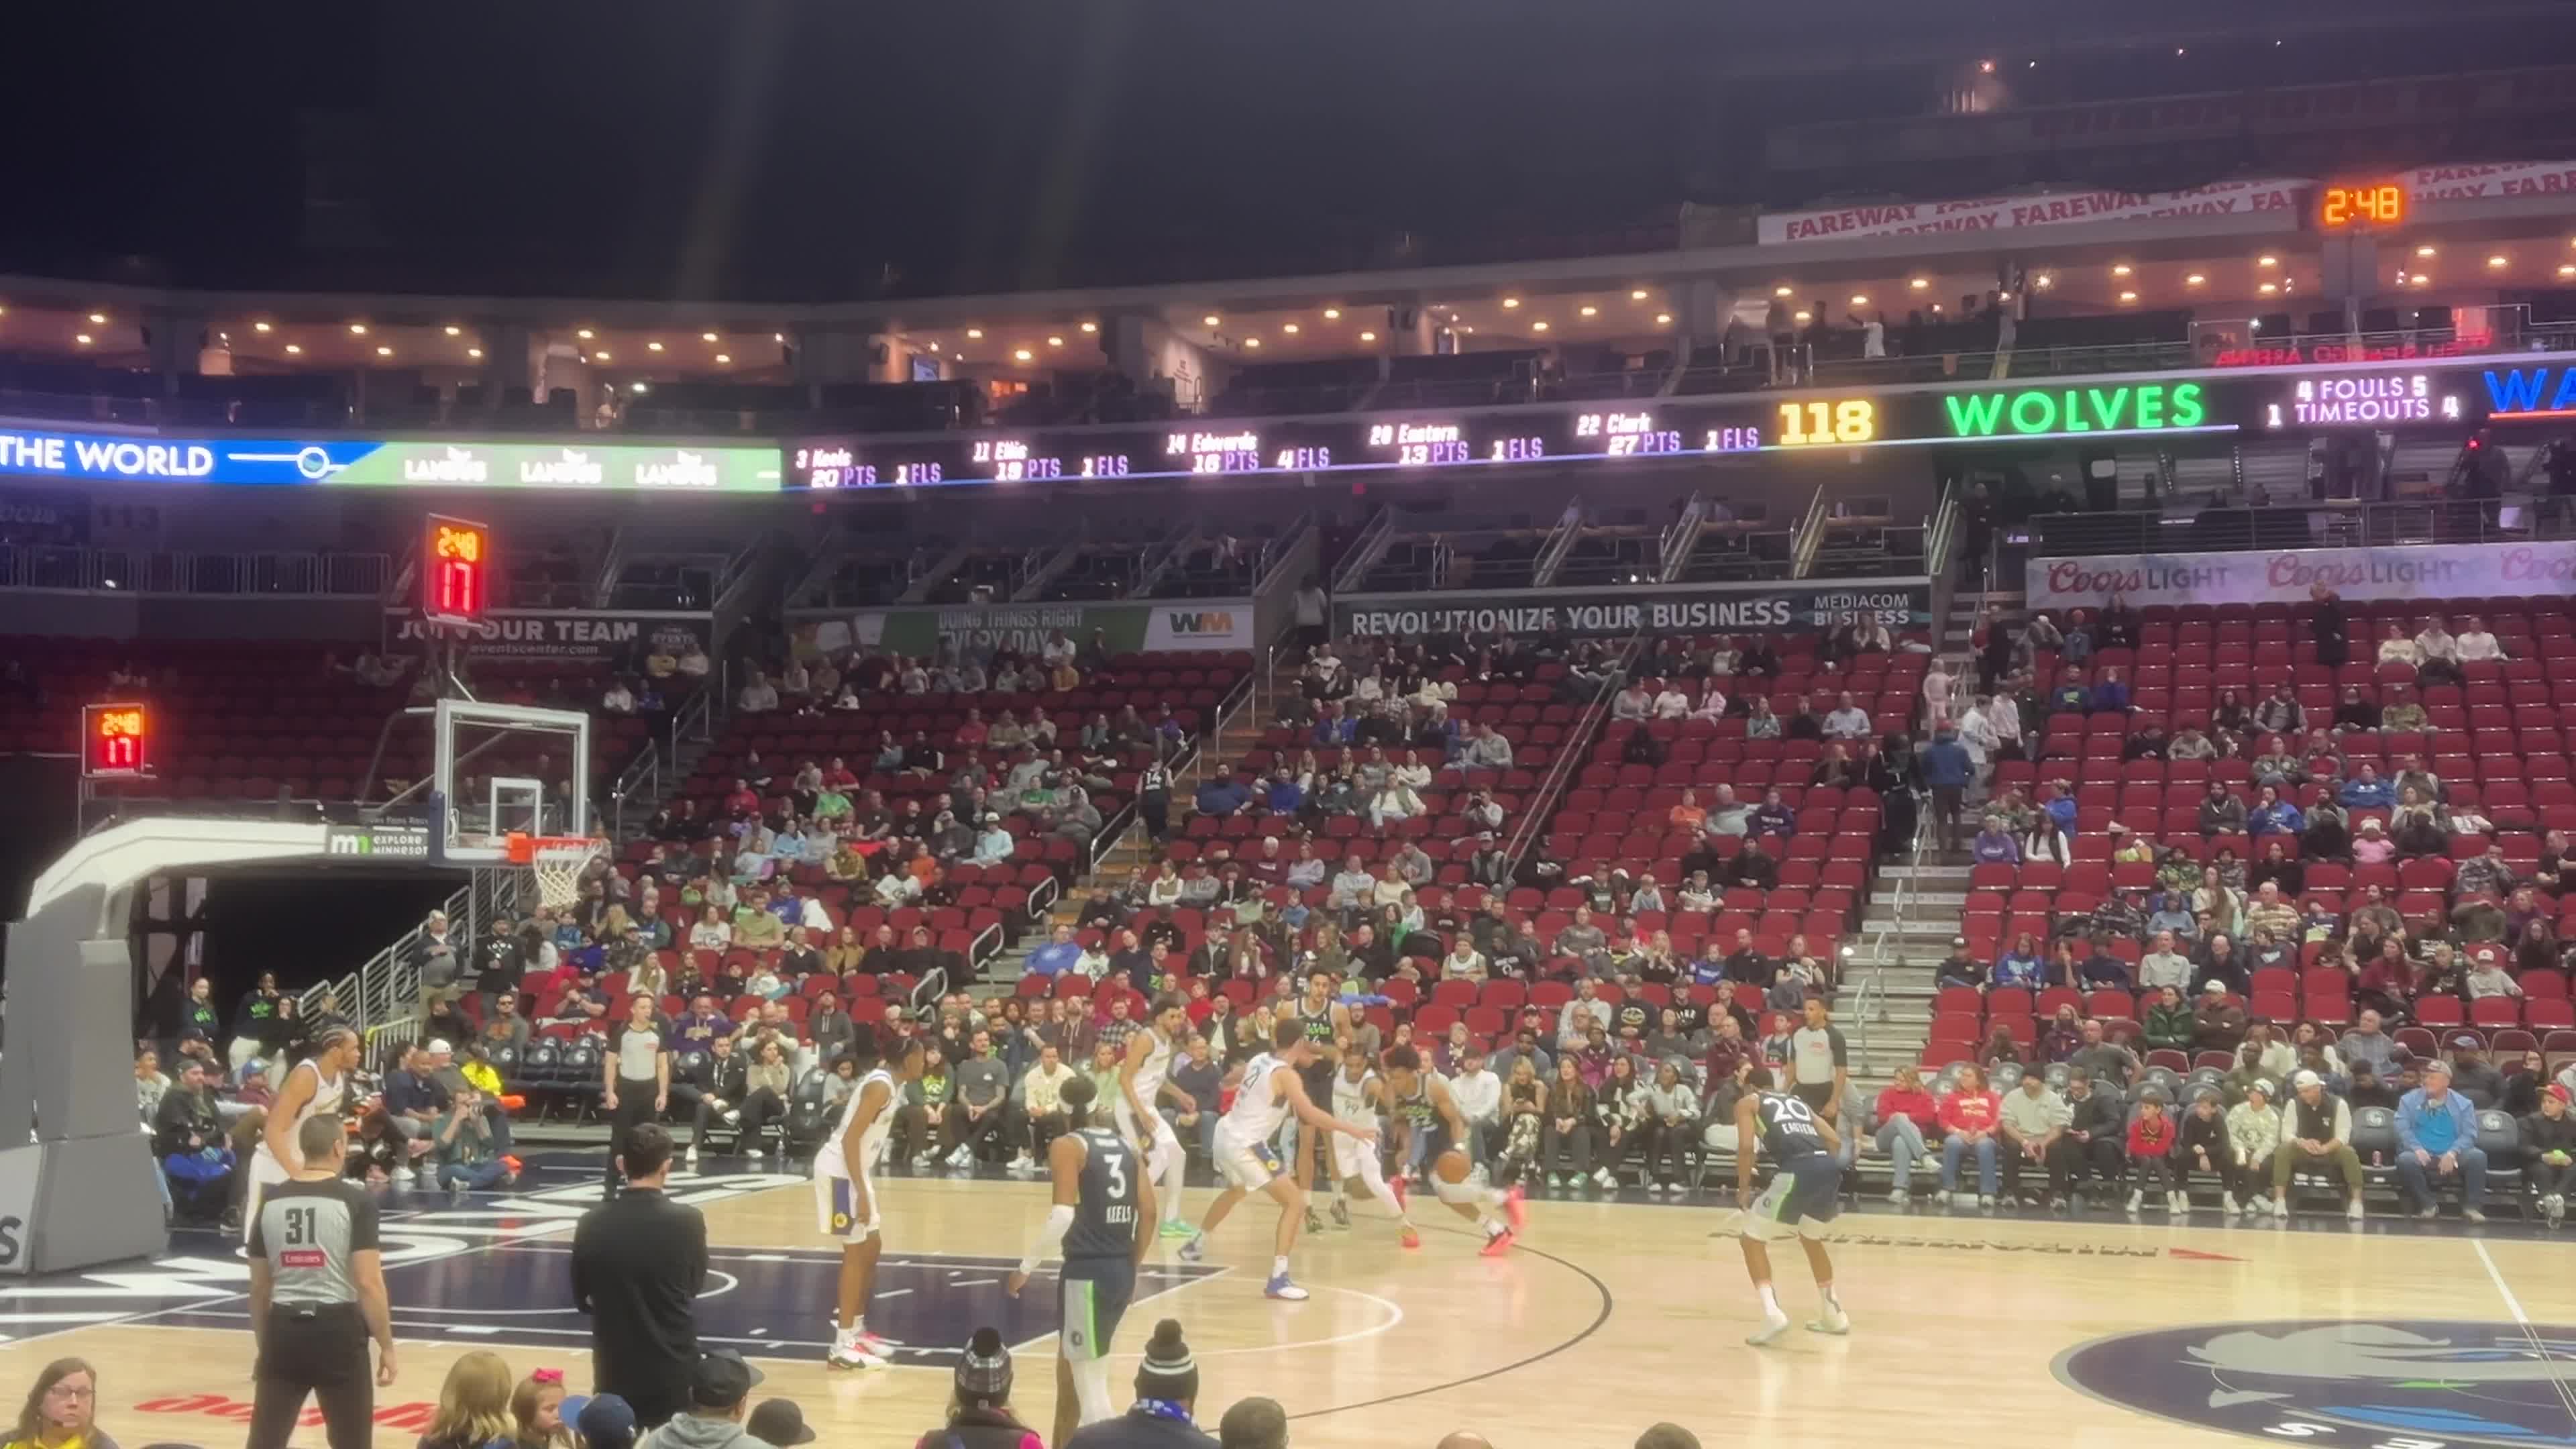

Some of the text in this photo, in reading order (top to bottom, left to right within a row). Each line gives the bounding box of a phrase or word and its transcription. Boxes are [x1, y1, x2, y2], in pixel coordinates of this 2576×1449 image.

[2324, 186, 2399, 224] 2:48
[1786, 203, 1917, 239] FAREWAY
[2297, 375, 2427, 402] 4 FOULS 5
[1779, 400, 1873, 444] 118
[1946, 382, 2203, 436] WOLVES
[2267, 396, 2459, 427] 1 TIMEOUTS 4
[1577, 415, 1601, 436] 22
[1399, 437, 1543, 464] 13 PTS 1 FLS
[1608, 427, 1758, 455] 27 PTS 1 FLS
[0, 436, 213, 476] THE WORLD
[796, 449, 808, 469] 3
[1028, 458, 1061, 478] PTS
[1081, 458, 1093, 477] 1
[1097, 455, 1128, 476] FLS
[1225, 451, 1259, 472] PTS
[1298, 446, 1330, 469] FLS
[844, 465, 876, 486] PTS
[896, 465, 908, 485] 1
[912, 462, 942, 484] FLS
[2047, 560, 2229, 594] Coors LIGHT
[2267, 553, 2458, 588] Coors LIGHT
[443, 561, 472, 612] 17
[1814, 593, 1909, 608] MEDIACOM
[1169, 613, 1233, 632] WM
[1566, 604, 1640, 629] YOUR
[1653, 600, 1791, 628] BUSINESS
[554, 621, 638, 641] TEAM
[109, 737, 132, 763] 17
[1762, 1097, 1812, 1123] 20
[1104, 1153, 1126, 1199] 3
[285, 1207, 316, 1244] 31
